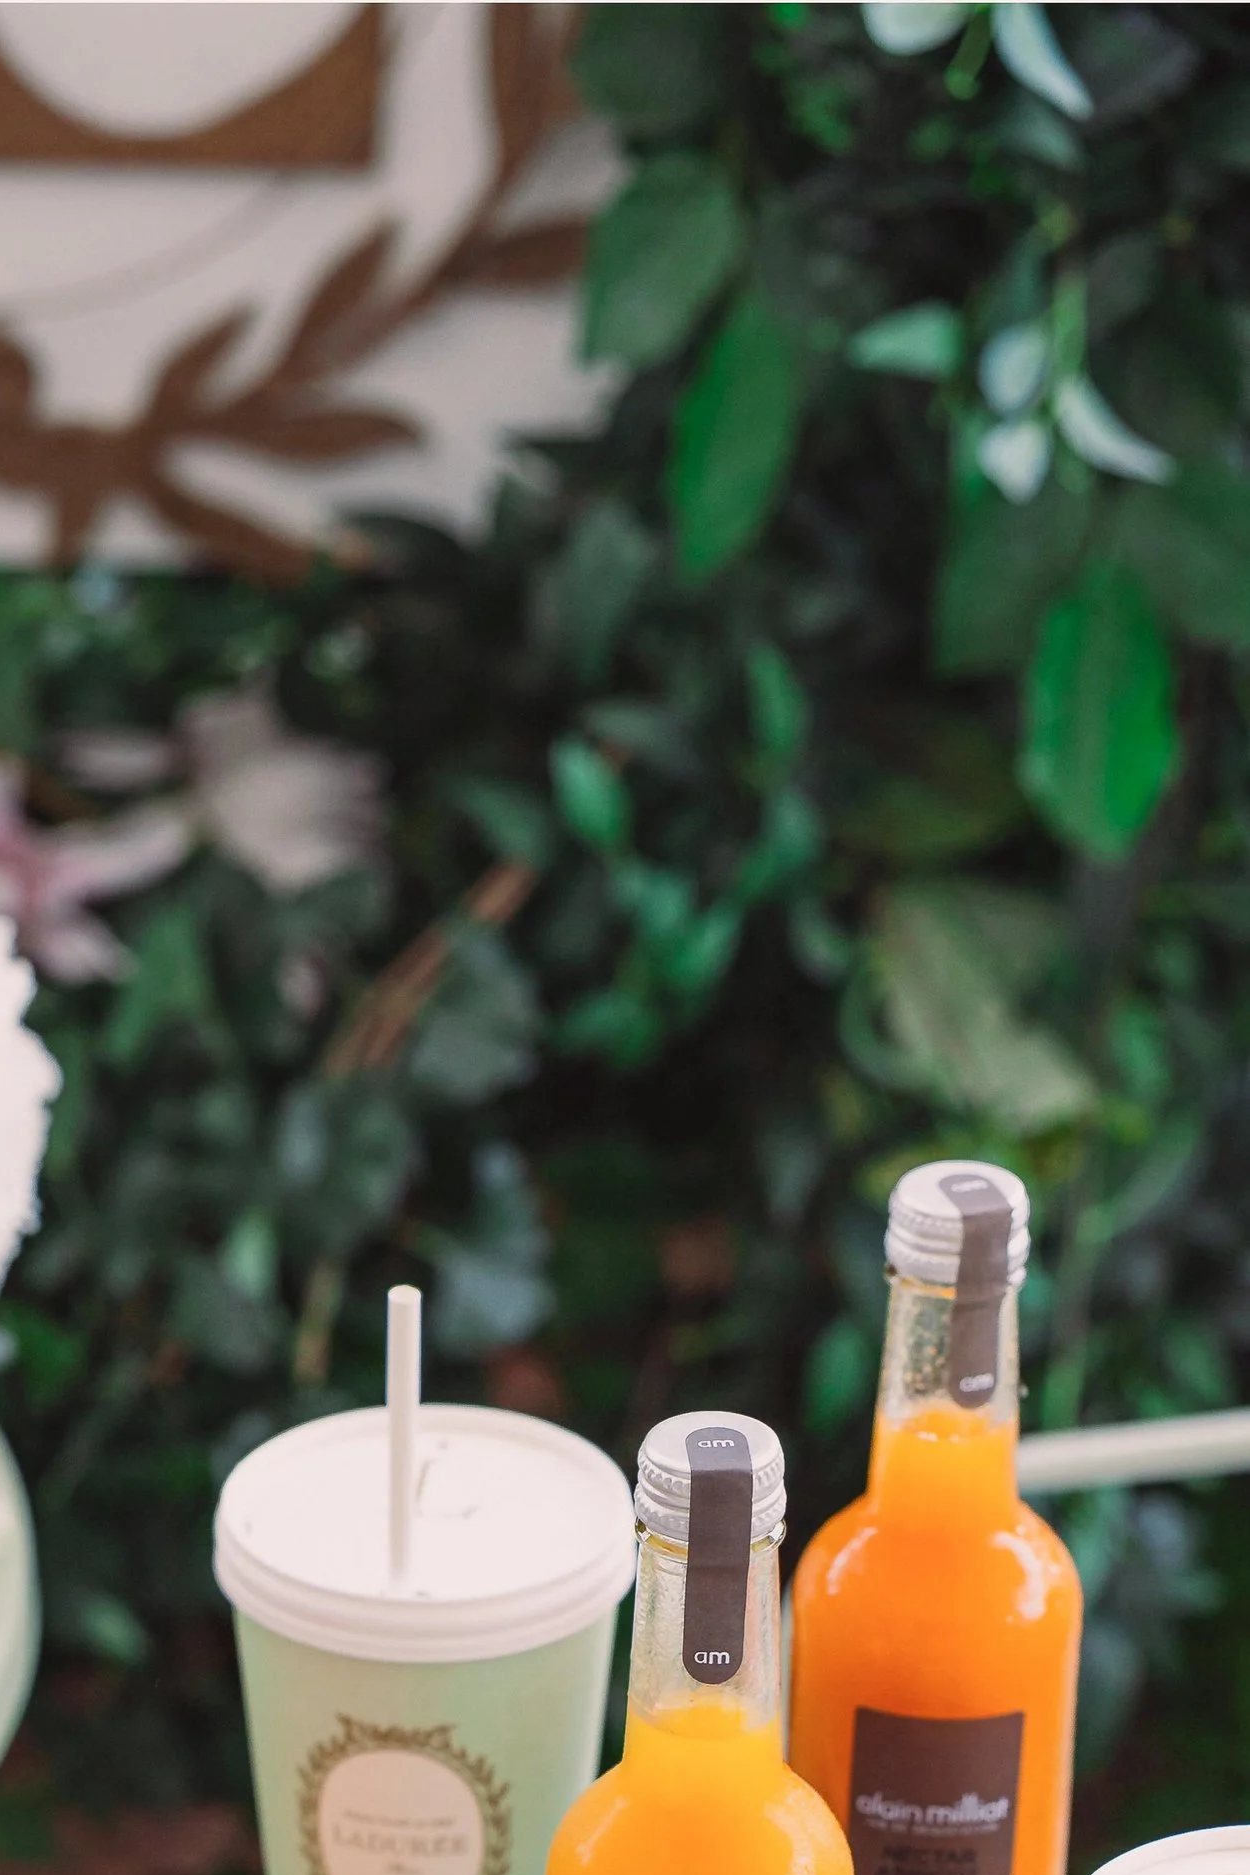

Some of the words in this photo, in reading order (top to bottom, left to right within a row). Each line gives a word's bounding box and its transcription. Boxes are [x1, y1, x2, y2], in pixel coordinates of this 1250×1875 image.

[697, 1437, 736, 1450] am
[693, 1651, 731, 1665] am
[855, 1791, 923, 1824] alain
[925, 1792, 1009, 1825] milliat
